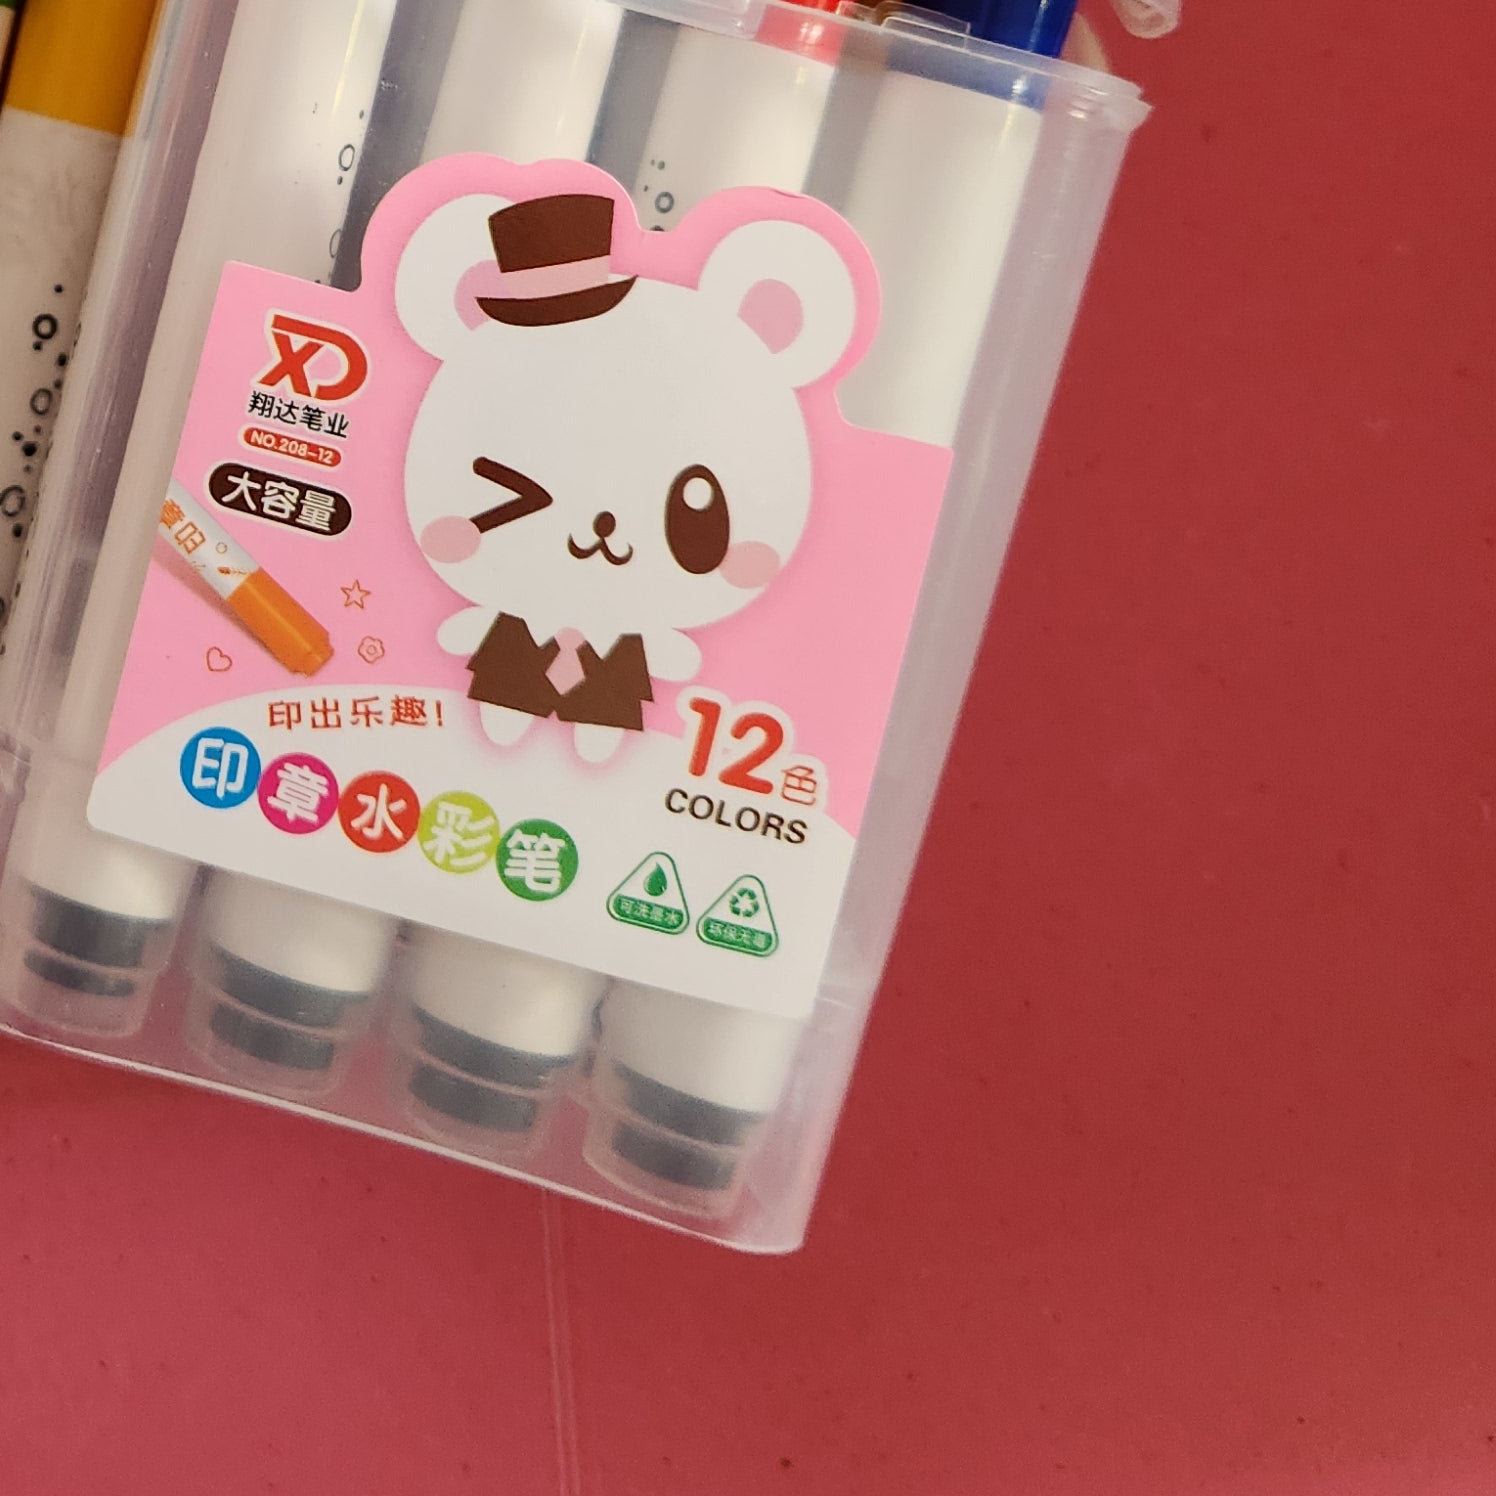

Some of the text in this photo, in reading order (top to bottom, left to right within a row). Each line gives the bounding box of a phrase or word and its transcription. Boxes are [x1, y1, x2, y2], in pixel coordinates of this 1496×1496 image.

[248, 390, 350, 439] 翔达笔业
[250, 429, 335, 466] NO.208-12
[221, 470, 336, 533] 大容量
[191, 736, 567, 894] 印章水彩笔
[664, 788, 809, 845] COLORS
